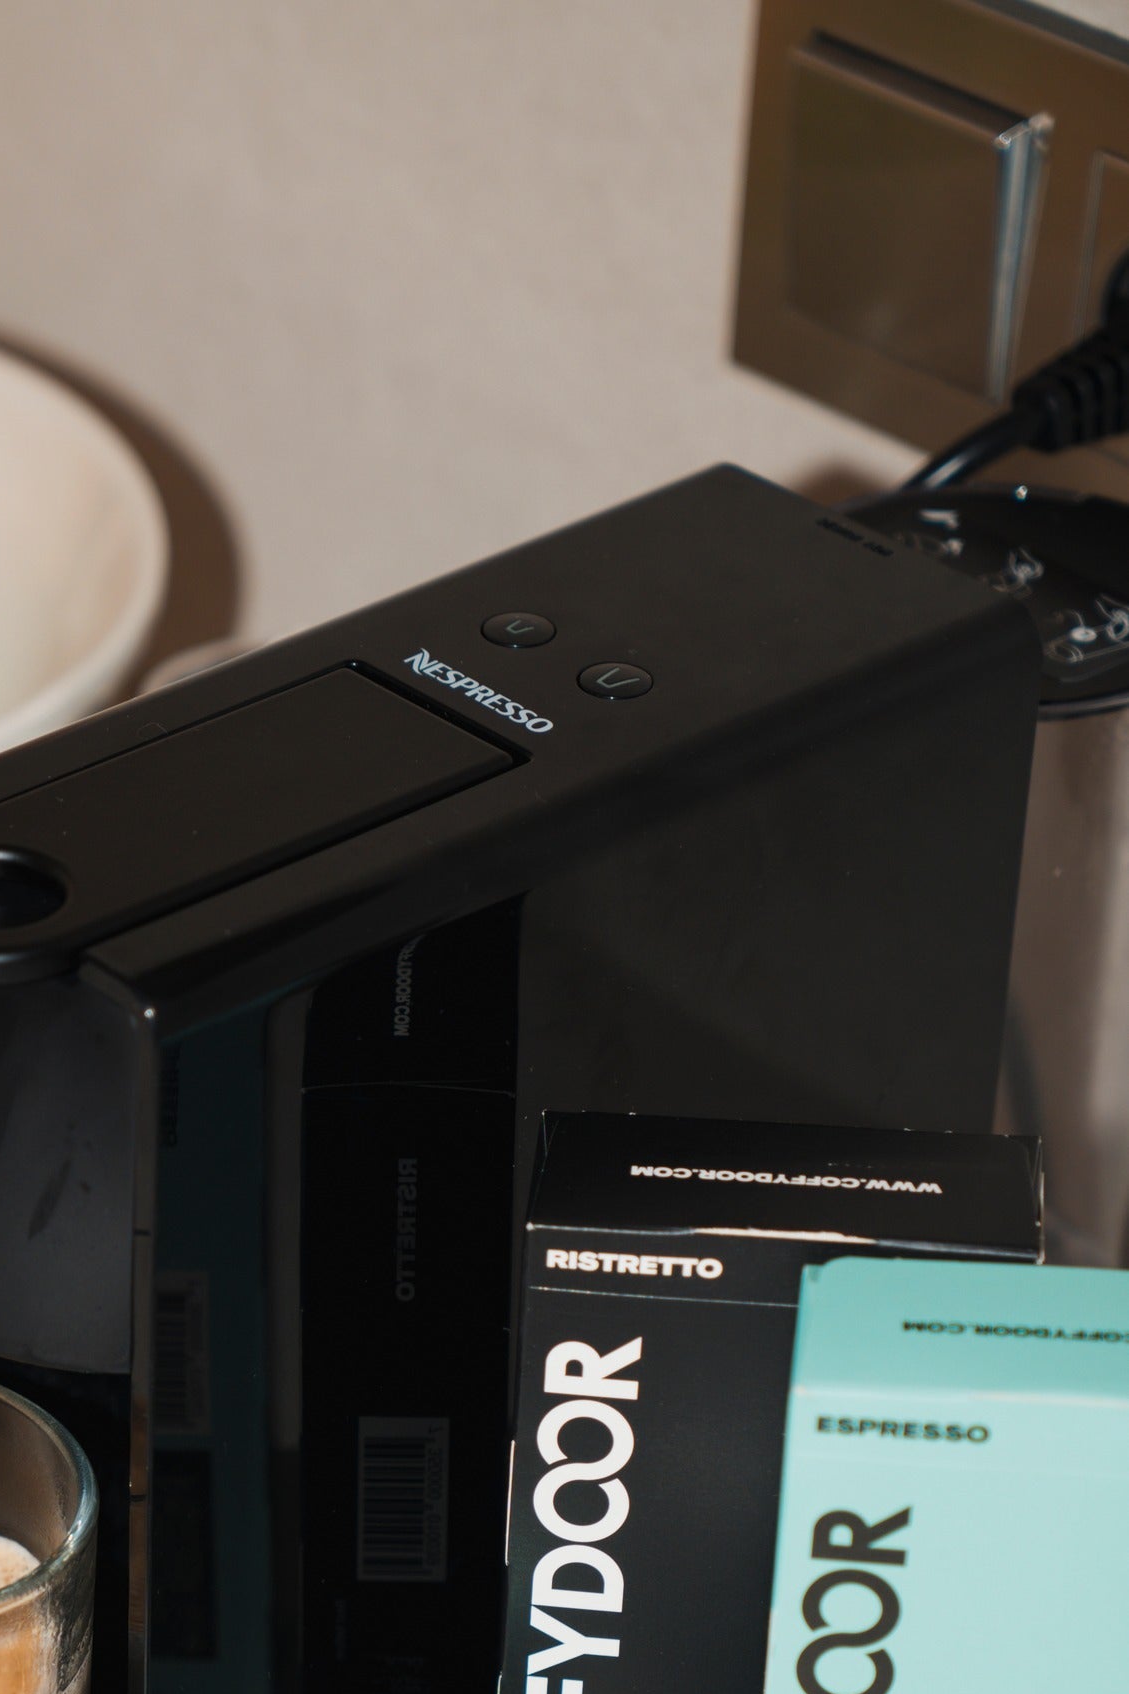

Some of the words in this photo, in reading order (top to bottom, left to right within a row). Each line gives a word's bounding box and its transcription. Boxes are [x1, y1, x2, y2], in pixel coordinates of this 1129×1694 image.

[403, 648, 554, 733] NESPRESSO
[630, 1165, 943, 1195] WWW.COFFYDOOR.COM
[546, 1249, 723, 1279] RISTRETTO
[816, 1416, 989, 1443] ESPRESSO
